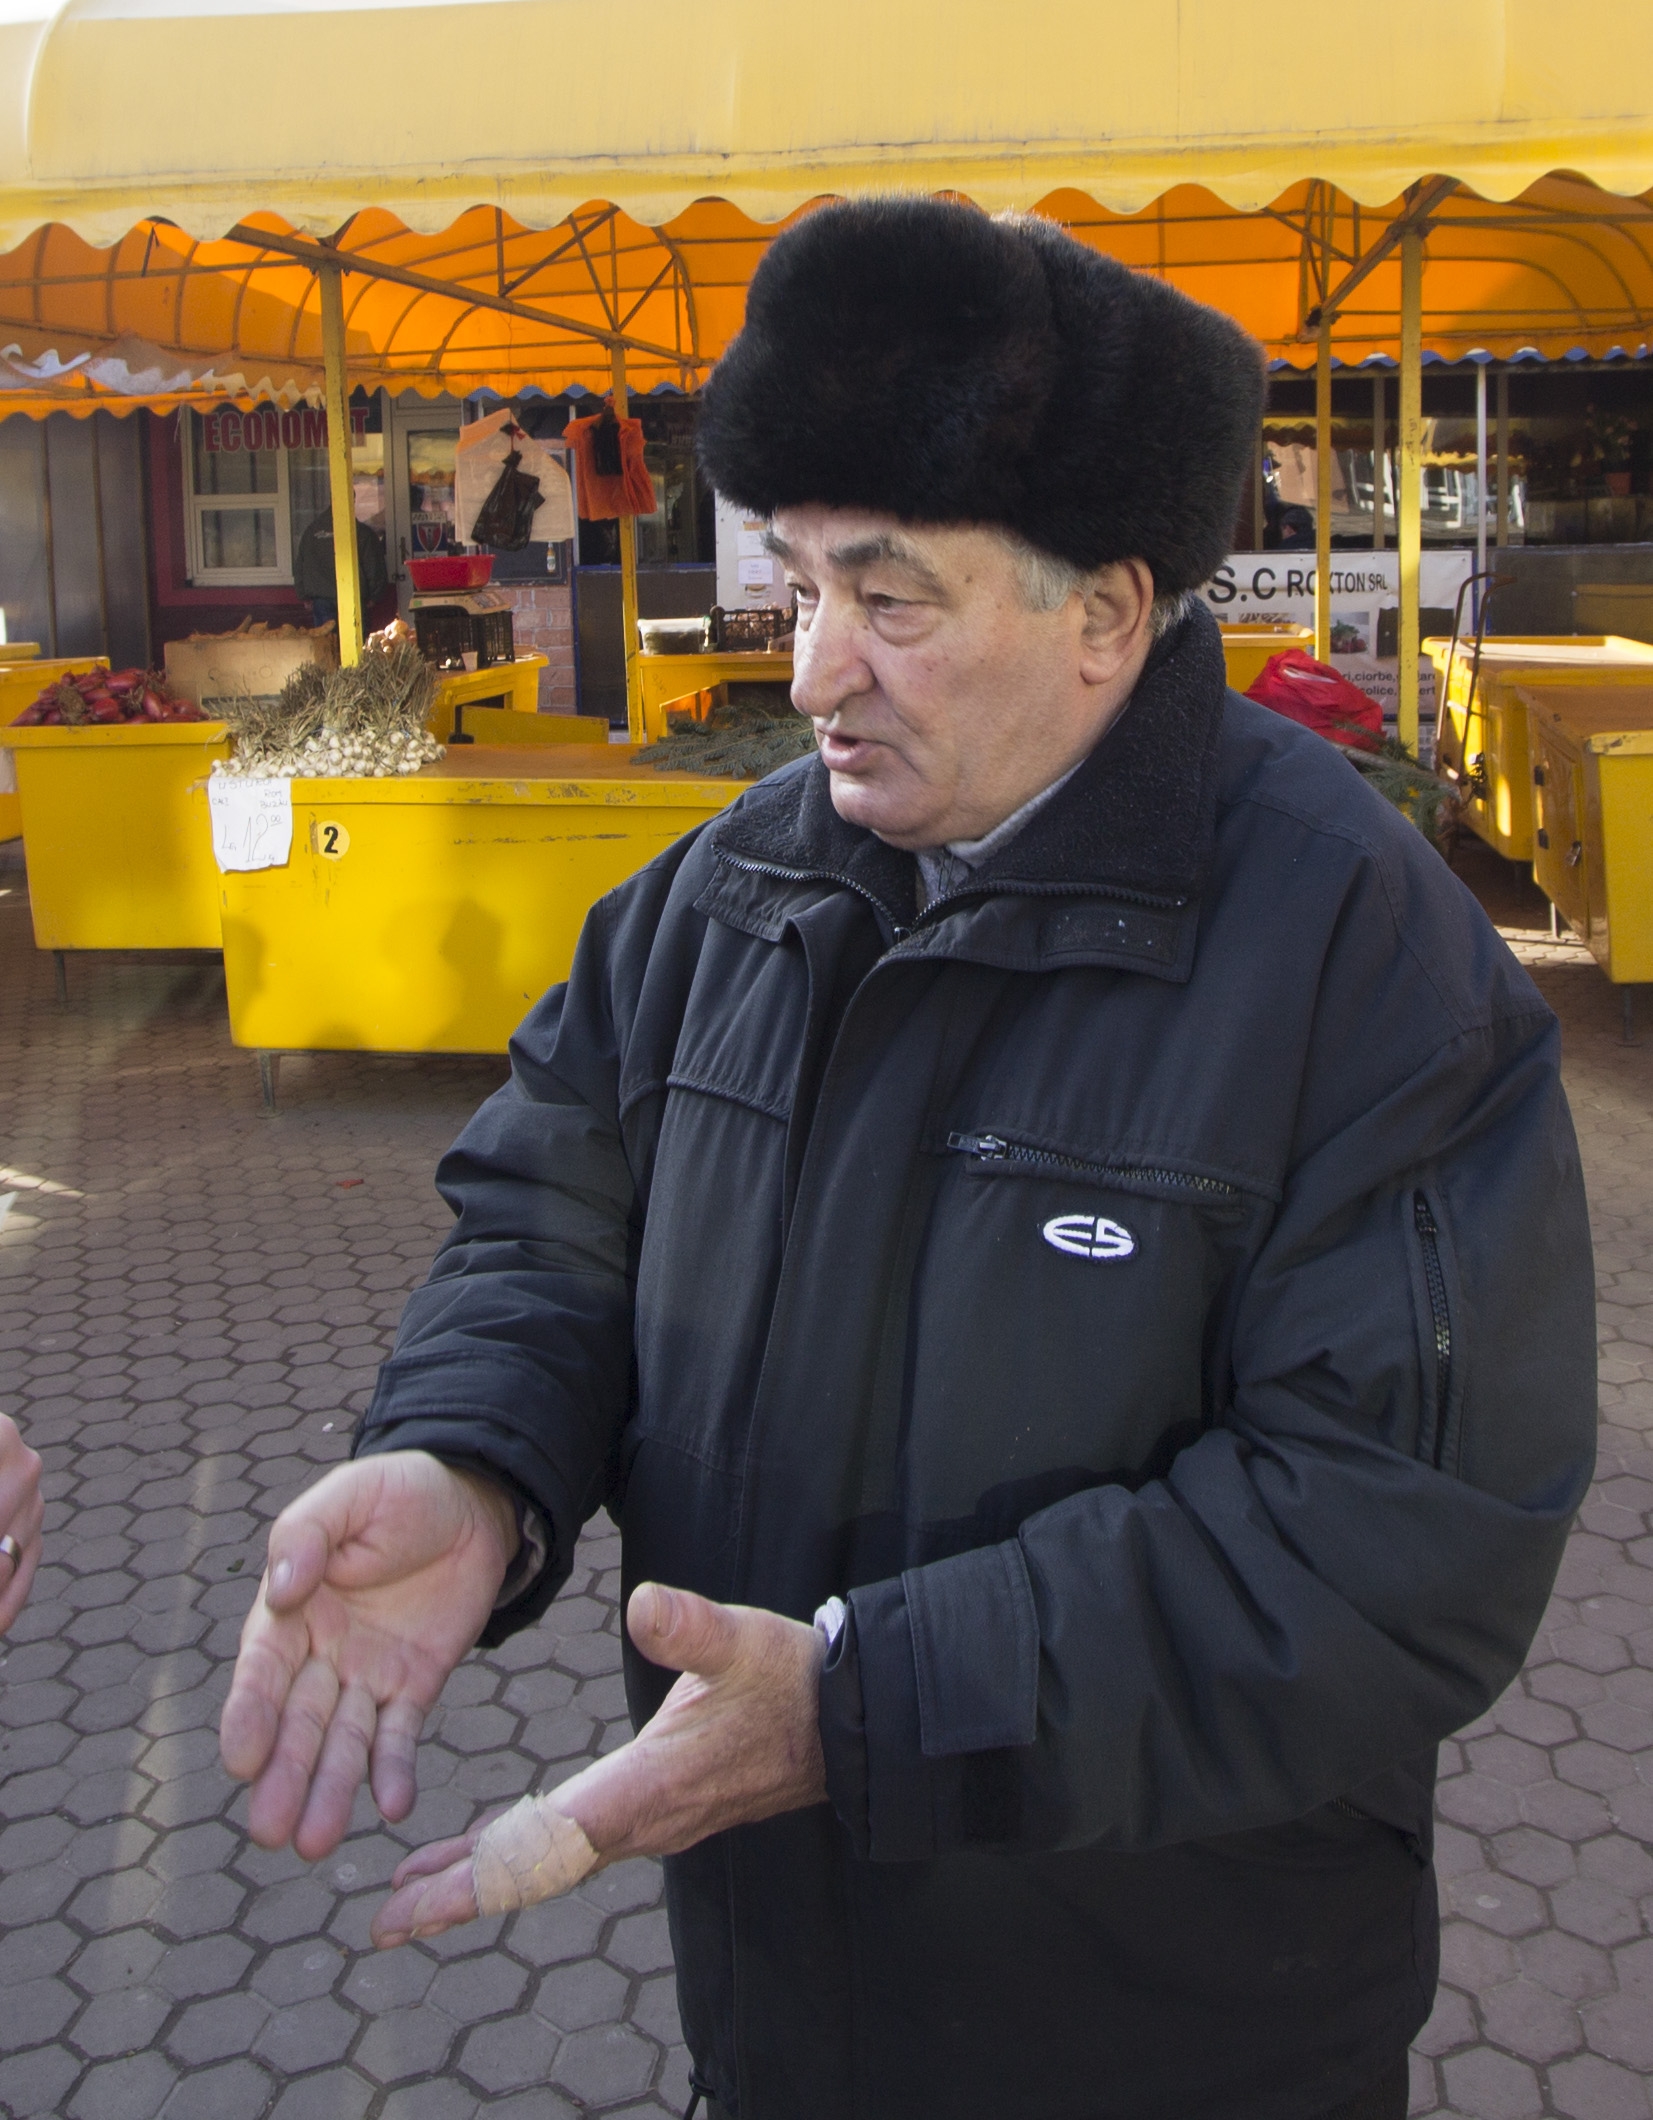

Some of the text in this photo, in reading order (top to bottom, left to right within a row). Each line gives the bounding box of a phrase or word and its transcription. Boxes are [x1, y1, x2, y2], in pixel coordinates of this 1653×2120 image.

[203, 407, 370, 453] ECONOMT
[1208, 565, 1276, 604] S.C
[1368, 572, 1388, 592] SRL
[323, 825, 339, 855] 2
